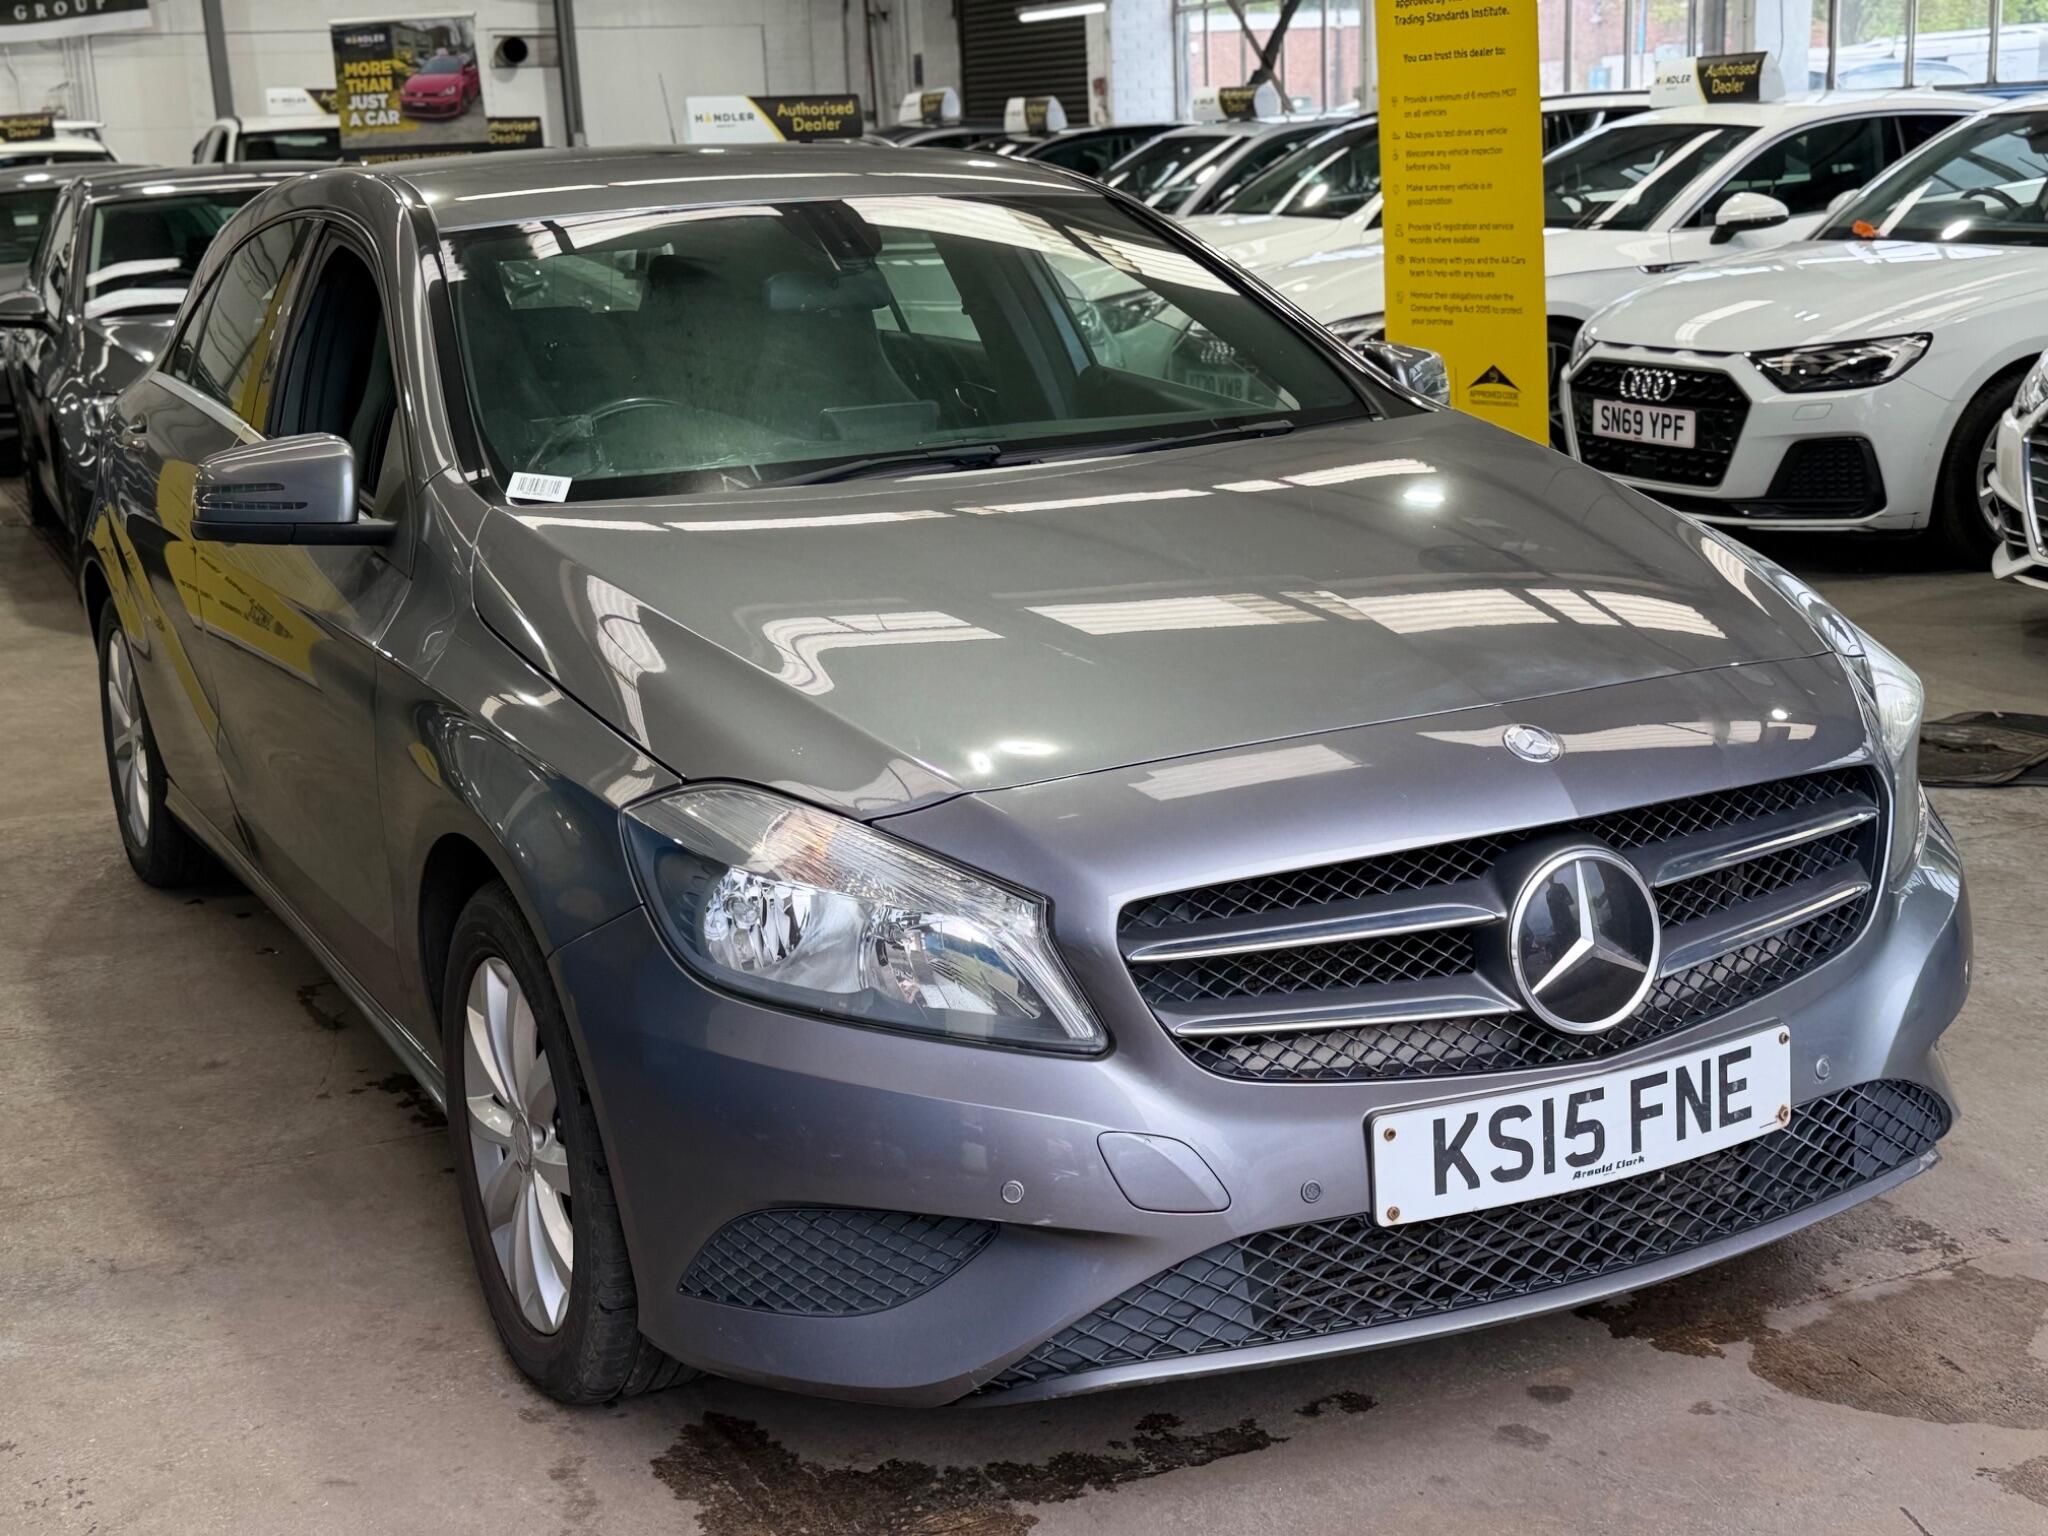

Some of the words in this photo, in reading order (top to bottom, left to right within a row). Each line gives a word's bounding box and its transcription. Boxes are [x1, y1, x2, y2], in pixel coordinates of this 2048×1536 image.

[1394, 14, 1425, 26] Trading
[1427, 10, 1469, 23] Standards
[1471, 6, 1509, 18] Institute.
[1403, 54, 1417, 63] You
[1418, 53, 1433, 62] can
[1434, 51, 1452, 60] trust
[1453, 49, 1468, 59] this
[1469, 47, 1494, 58] dealer
[344, 59, 393, 77] MORE
[1705, 60, 1759, 77] Authorised
[345, 77, 393, 93] THAN
[1711, 79, 1745, 94] Dealer
[348, 93, 389, 111] JUST
[777, 101, 854, 117] Authorised
[350, 112, 362, 128] A
[364, 110, 400, 126] CAR
[793, 117, 841, 132] Dealer
[1601, 405, 1644, 436] SN69
[1649, 411, 1686, 441] YPF
[1433, 1086, 1605, 1196] KS15
[1631, 1045, 1752, 1154] FNE
[1572, 1163, 1613, 1180] Arnold
[1616, 1156, 1645, 1169] Clark
